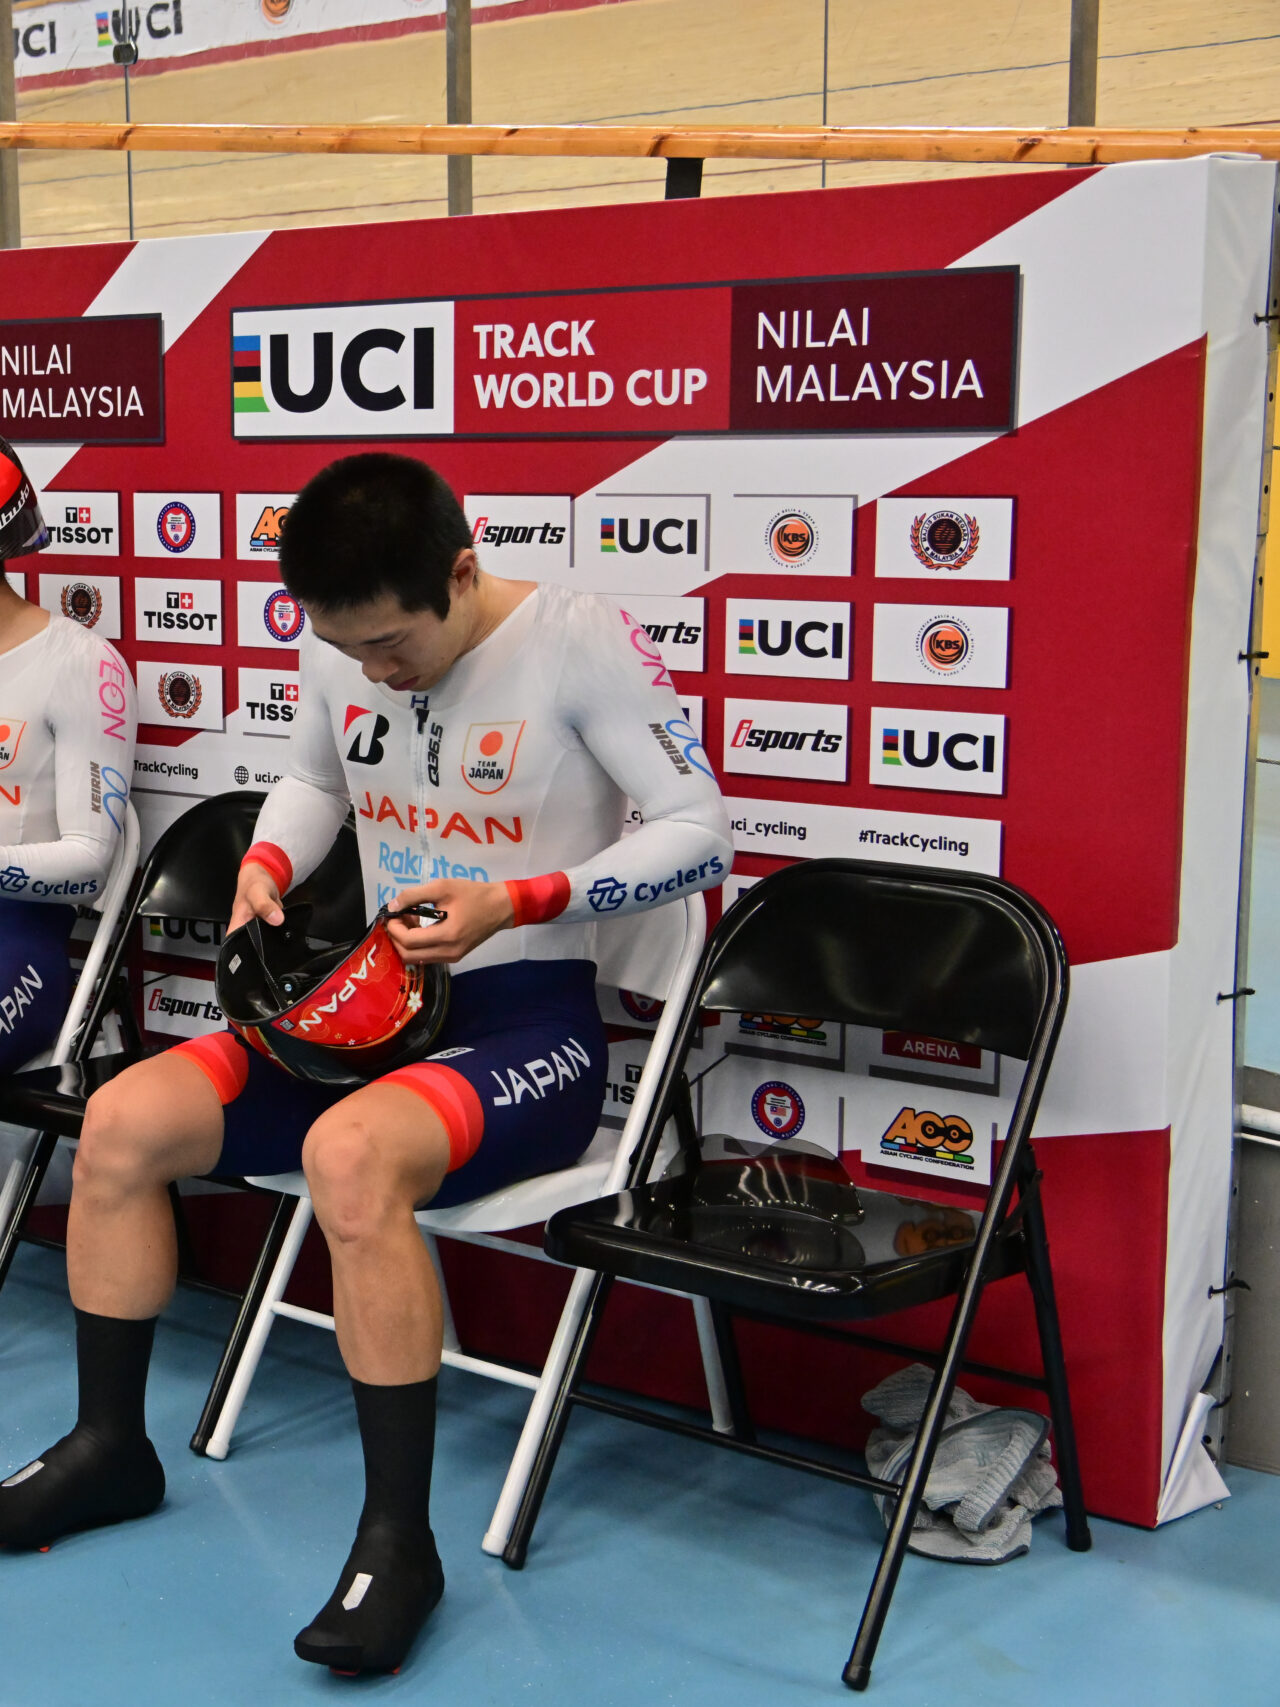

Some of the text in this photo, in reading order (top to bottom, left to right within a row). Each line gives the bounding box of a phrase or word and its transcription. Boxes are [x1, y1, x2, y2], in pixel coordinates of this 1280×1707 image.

[473, 320, 596, 360] TRACK
[756, 306, 870, 350] NILAI
[0, 343, 72, 376] NILAI
[269, 327, 435, 414] UCI
[473, 367, 708, 410] WORLD CUP
[754, 359, 986, 404] MALAYSIA
[2, 386, 145, 419] MALAYSIA
[48, 526, 114, 545] TISSOT
[472, 517, 566, 547] isports
[618, 518, 698, 555] UCI
[783, 532, 806, 545] KBS
[143, 610, 218, 632] TISSOT
[757, 619, 844, 659] UCI
[935, 639, 960, 652] KBS
[246, 701, 297, 723] TISS
[648, 722, 693, 776] KEIRIN
[730, 719, 843, 753] isports
[902, 729, 996, 773] UCI
[133, 759, 199, 780] TrackCycling
[427, 722, 444, 788] Q36.5
[477, 760, 497, 768] TEAM
[90, 760, 102, 815] KEIRIN
[468, 767, 504, 780] JAPAN
[359, 791, 523, 845] JAPAN
[858, 829, 969, 856] #TrackCycling
[31, 878, 98, 897] Cyclers
[634, 855, 724, 903] Cyclers
[148, 988, 223, 1022] isports
[299, 944, 377, 1032] JAPAN
[902, 1039, 961, 1061] ARENA
[491, 1037, 591, 1107] JAPAN
[881, 1106, 974, 1154] ACC
[880, 1149, 975, 1171] ASIAN CYCLING CONFEDERATION
